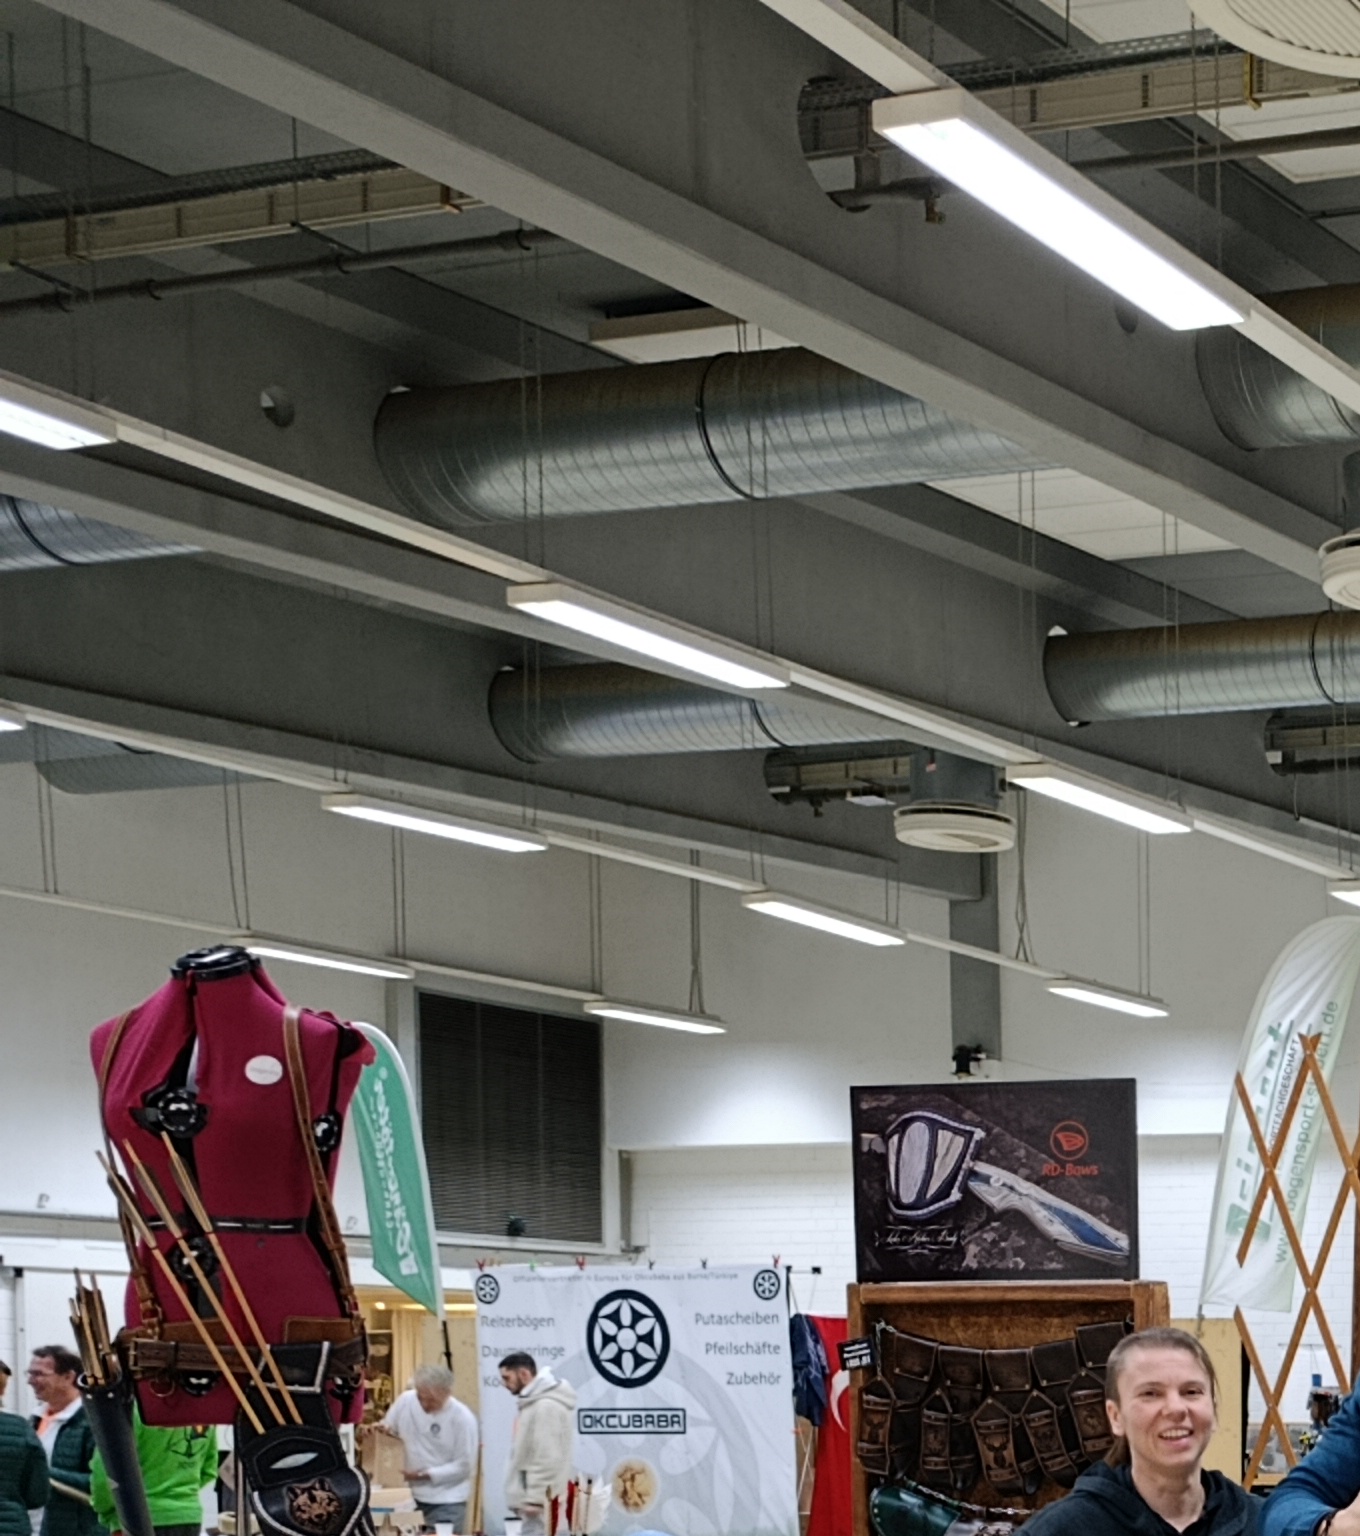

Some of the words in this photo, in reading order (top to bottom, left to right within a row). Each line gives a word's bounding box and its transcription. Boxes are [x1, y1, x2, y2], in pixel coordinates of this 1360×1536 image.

[1041, 1163, 1099, 1176] RD-Bows
[481, 1315, 555, 1330] Reiterbögen
[695, 1312, 779, 1326] Putascheiben
[705, 1341, 781, 1357] Pfeilschäfte
[726, 1371, 782, 1386] Zubehör
[582, 1414, 682, 1429] OKCUBABA
